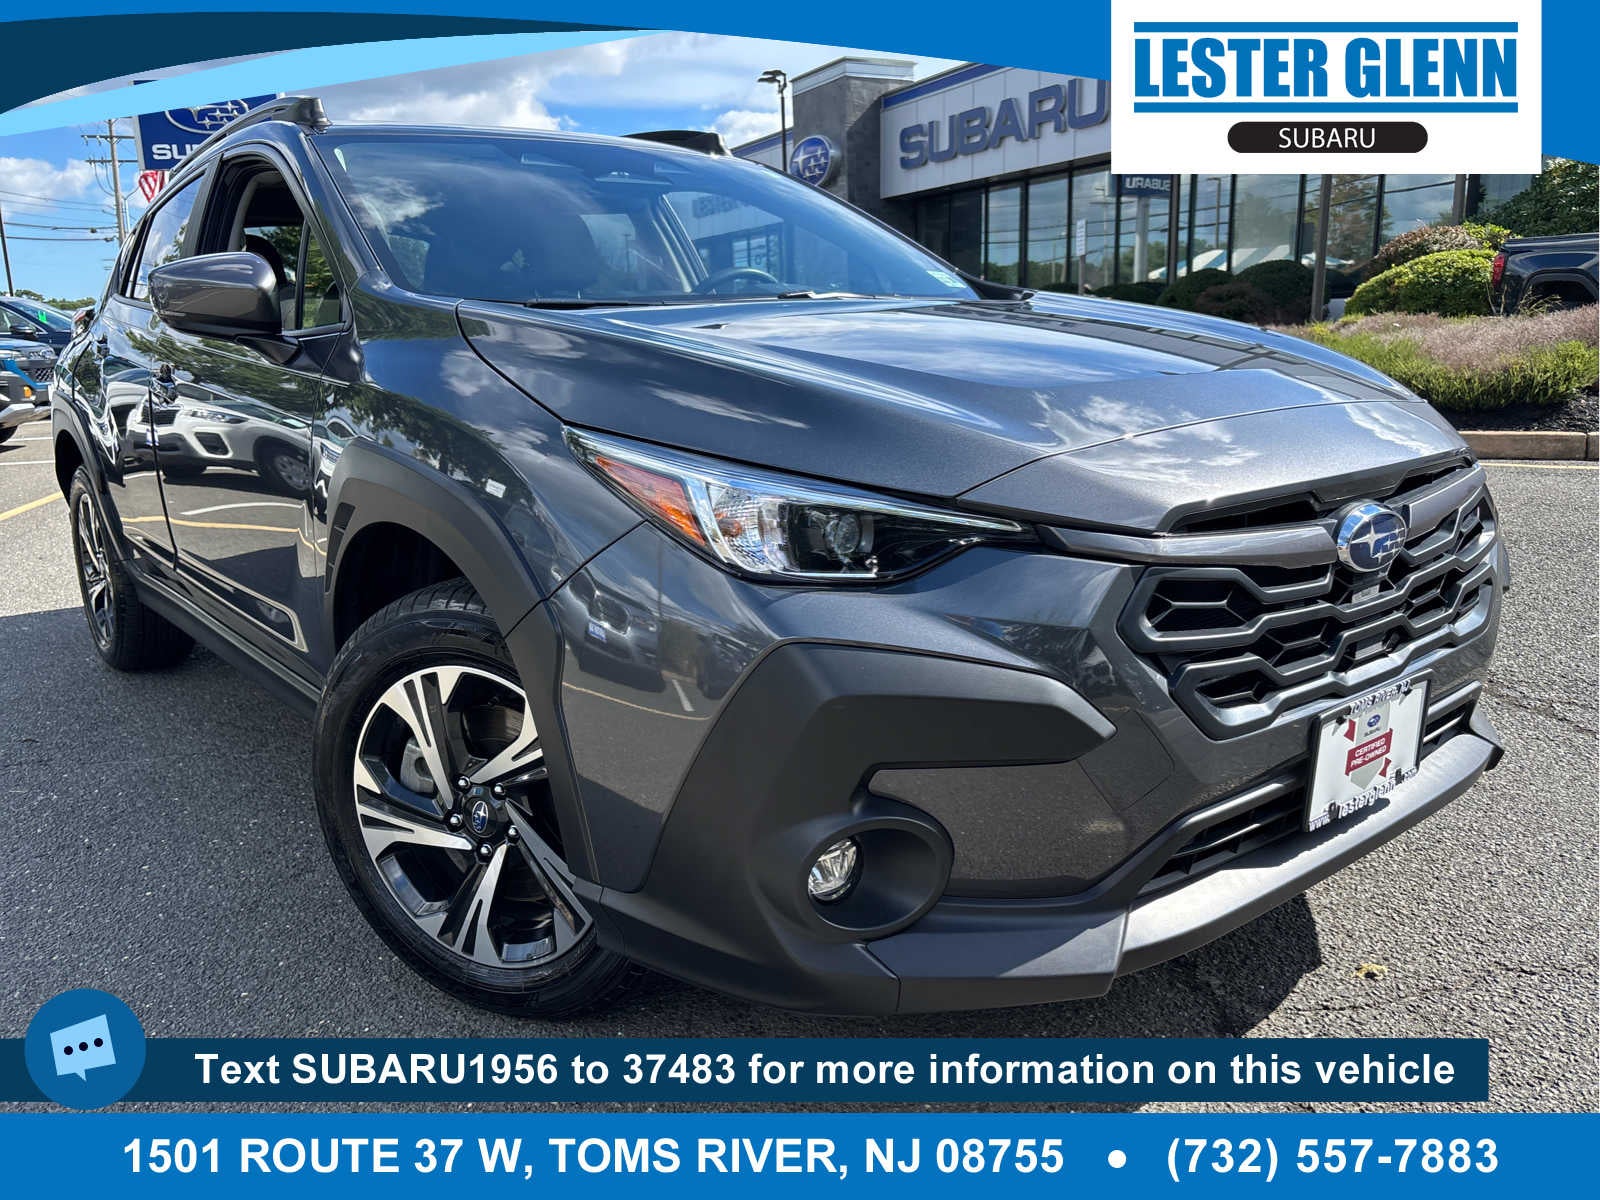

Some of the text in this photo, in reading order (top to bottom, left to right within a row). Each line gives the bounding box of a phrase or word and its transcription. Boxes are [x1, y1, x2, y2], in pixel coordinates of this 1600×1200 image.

[900, 78, 1109, 169] SUBARU
[152, 143, 199, 160] SU
[1350, 745, 1387, 768] PRE-OWNED
[1355, 738, 1386, 757] CERTIFIED
